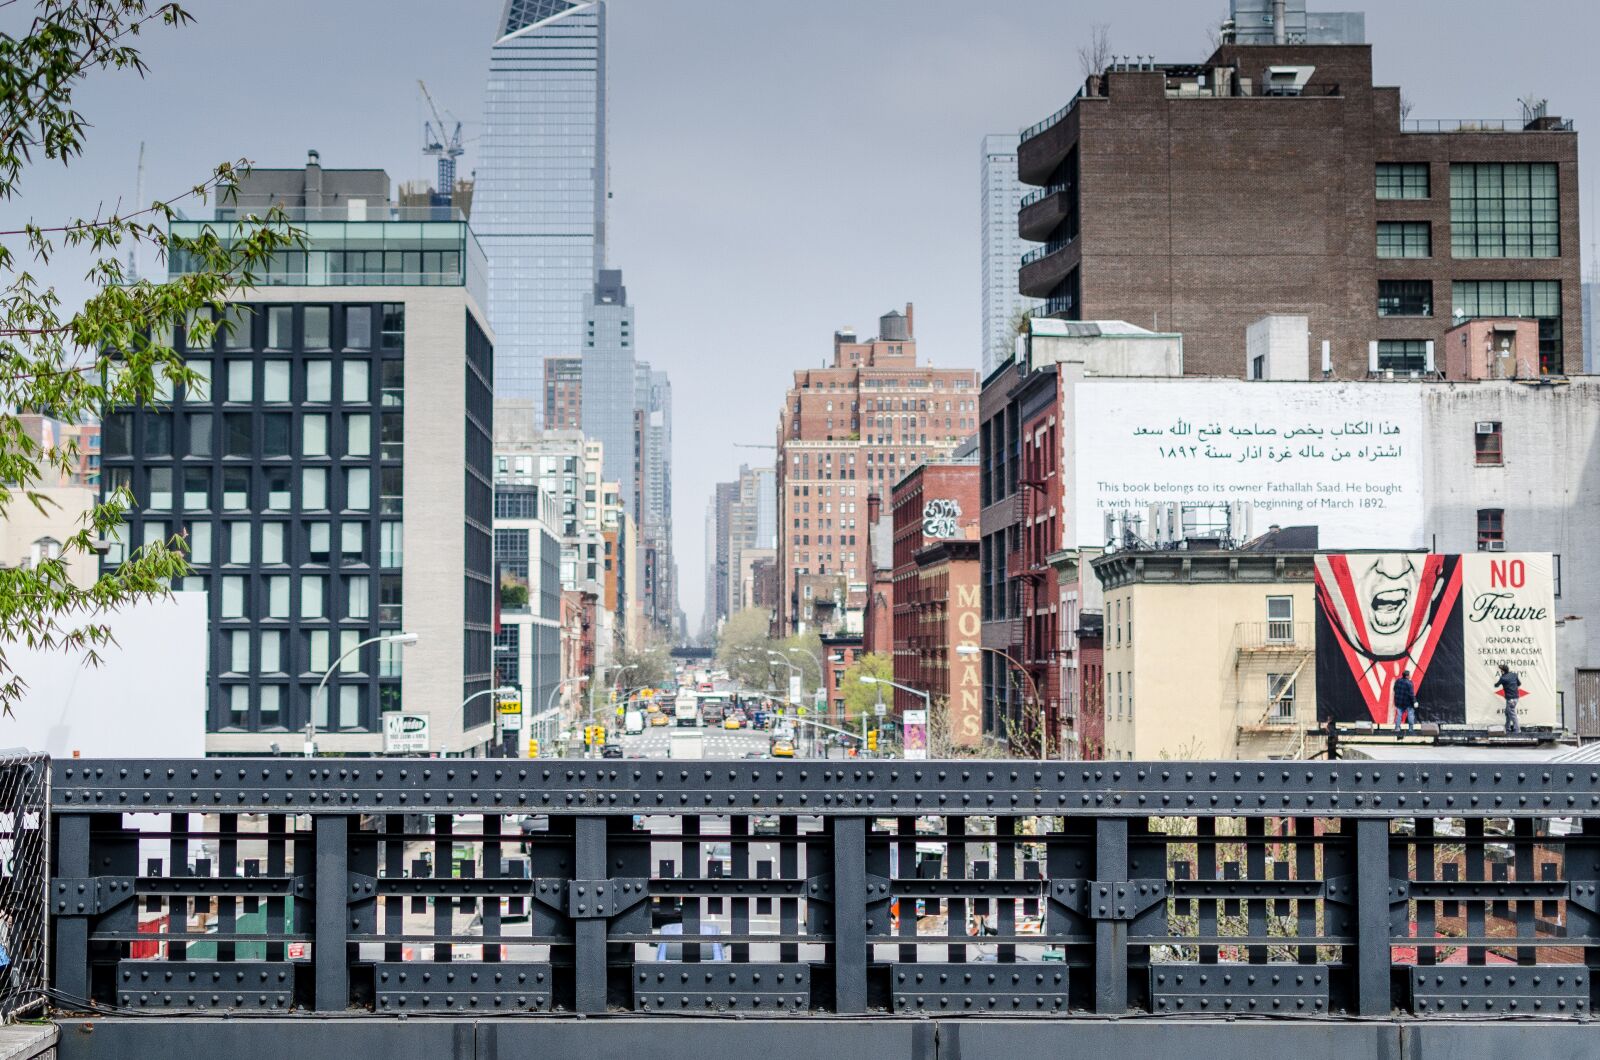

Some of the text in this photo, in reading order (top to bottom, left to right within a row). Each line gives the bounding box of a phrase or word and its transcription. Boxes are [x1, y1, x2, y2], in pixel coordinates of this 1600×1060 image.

[1132, 417, 1401, 442] هذا الكتاب يخص صاحبه فتح الله سعد
[1159, 444, 1402, 463] اشتراه من ماله غرة اذار سنة ١٨٩٢
[1097, 481, 1403, 496] This book belongs to its owner Fathallah Saad. He bought
[1096, 498, 1104, 508] it
[1107, 498, 1131, 508] with
[1134, 498, 1149, 508] his
[1252, 498, 1303, 511] beginning
[1306, 498, 1318, 509] of
[1320, 498, 1354, 509] March
[1359, 498, 1388, 509] 1892.
[1490, 559, 1525, 589] NO
[1469, 592, 1547, 622] Future
[1500, 625, 1521, 633] FOR
